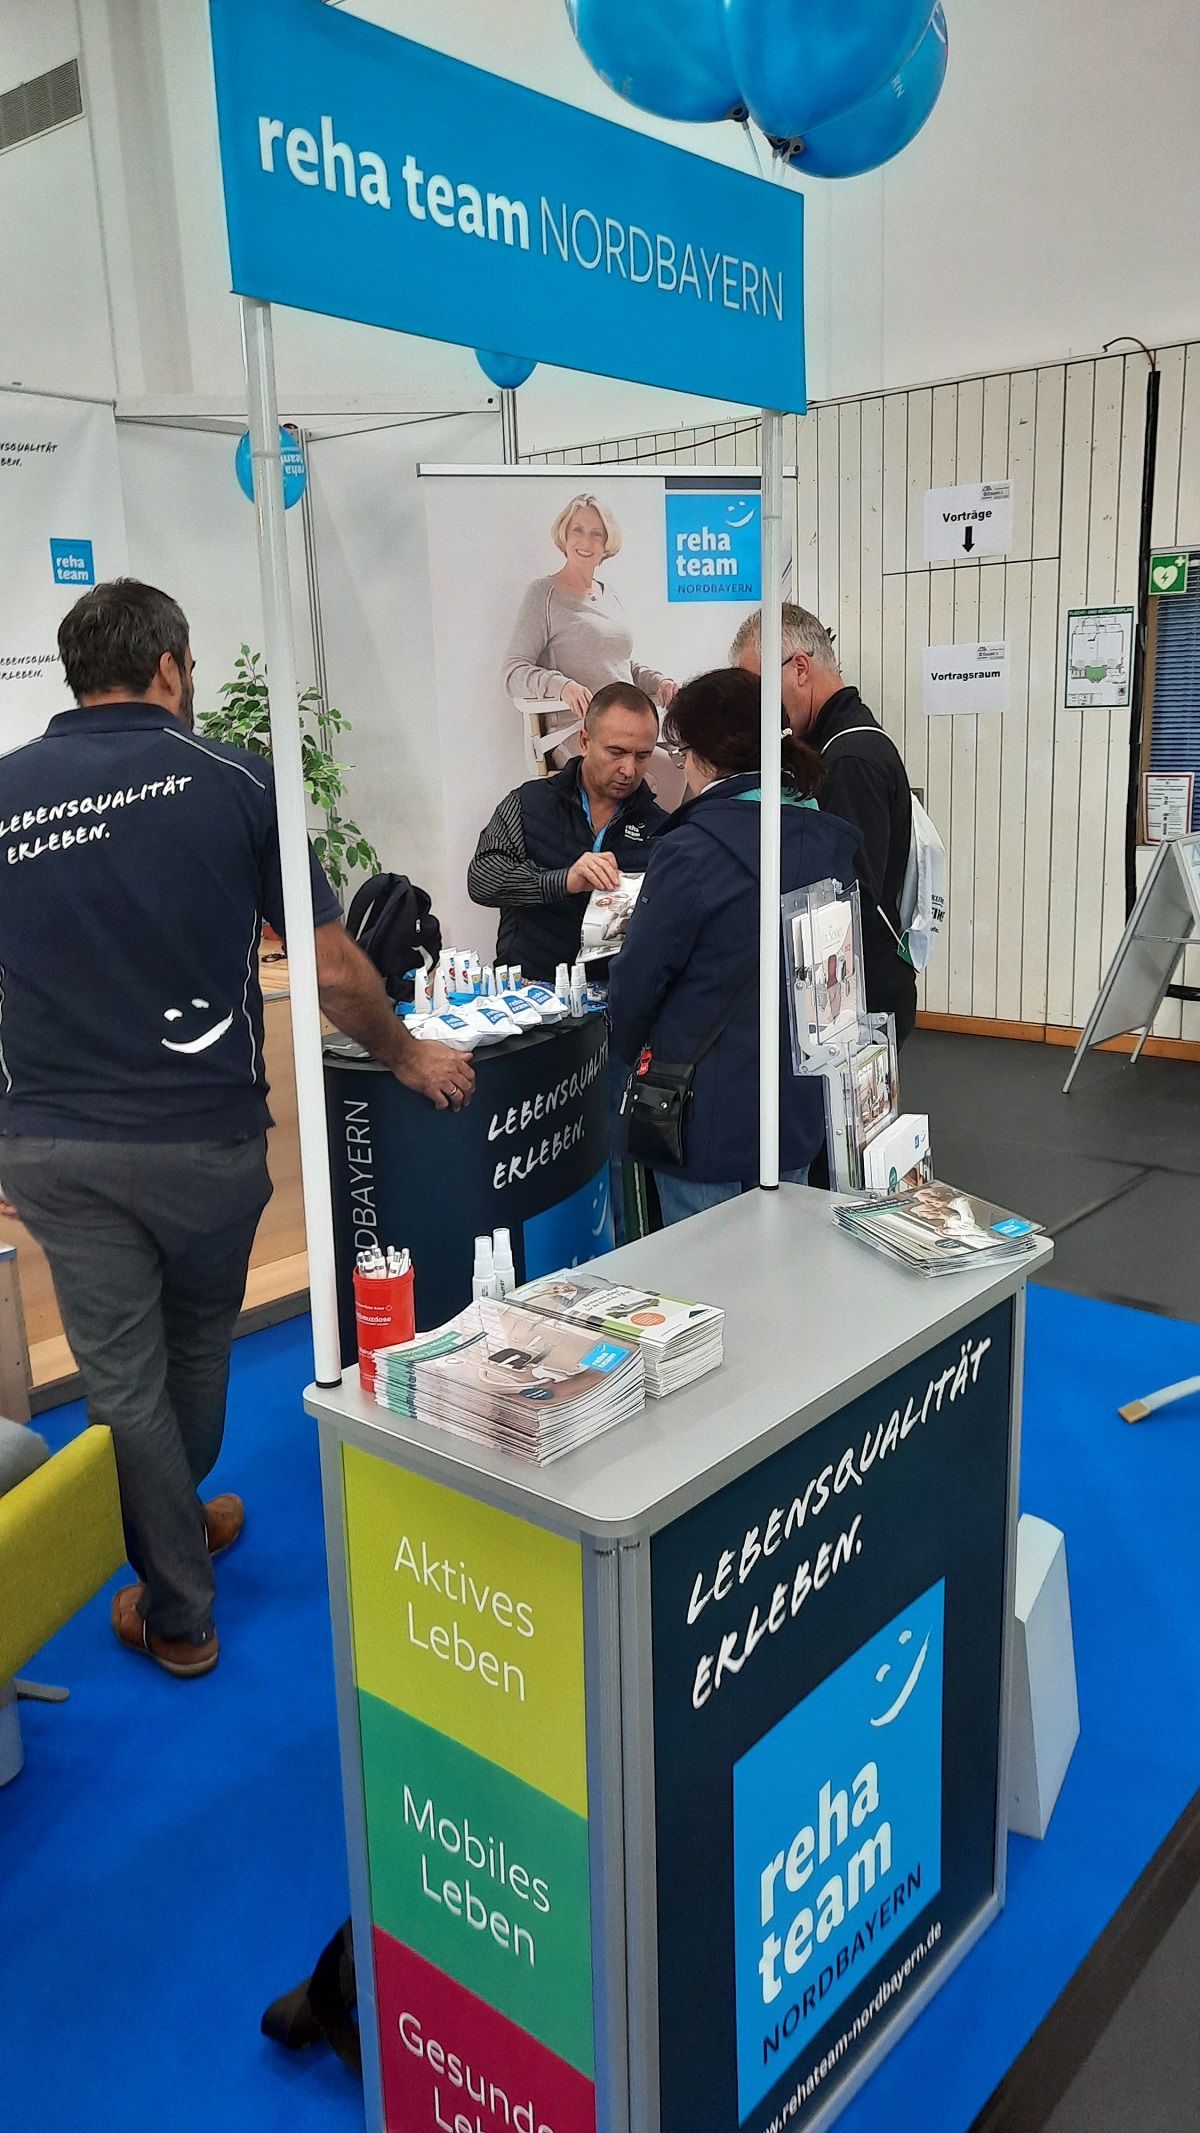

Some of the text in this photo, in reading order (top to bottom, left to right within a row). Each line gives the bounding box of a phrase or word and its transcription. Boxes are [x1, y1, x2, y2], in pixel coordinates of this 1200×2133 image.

[258, 115, 783, 321] reha team NORDBAYERN
[676, 527, 731, 551] reha
[942, 508, 993, 523] Vorträge
[55, 554, 85, 569] reha
[57, 568, 89, 581] team
[676, 555, 738, 577] team
[677, 584, 753, 594] NORDBAYERN
[931, 669, 1001, 683] Vortragsraum
[0, 774, 193, 838] LEBENSQUALITÄT
[7, 822, 111, 865] ERLEBEN.
[492, 1114, 585, 1190] ERLEBEN.
[686, 1336, 992, 1625] LEBENSQUALITÄT
[394, 1535, 536, 1639] Aktives
[692, 1513, 863, 1710] ERLEBEN.
[407, 1601, 527, 1702] Leben
[402, 1784, 551, 1913] Mobiles
[760, 1761, 880, 1928] reha
[421, 1853, 536, 1967] Leben
[758, 1821, 893, 2005] team
[762, 1862, 922, 2066] NORDBAYERN
